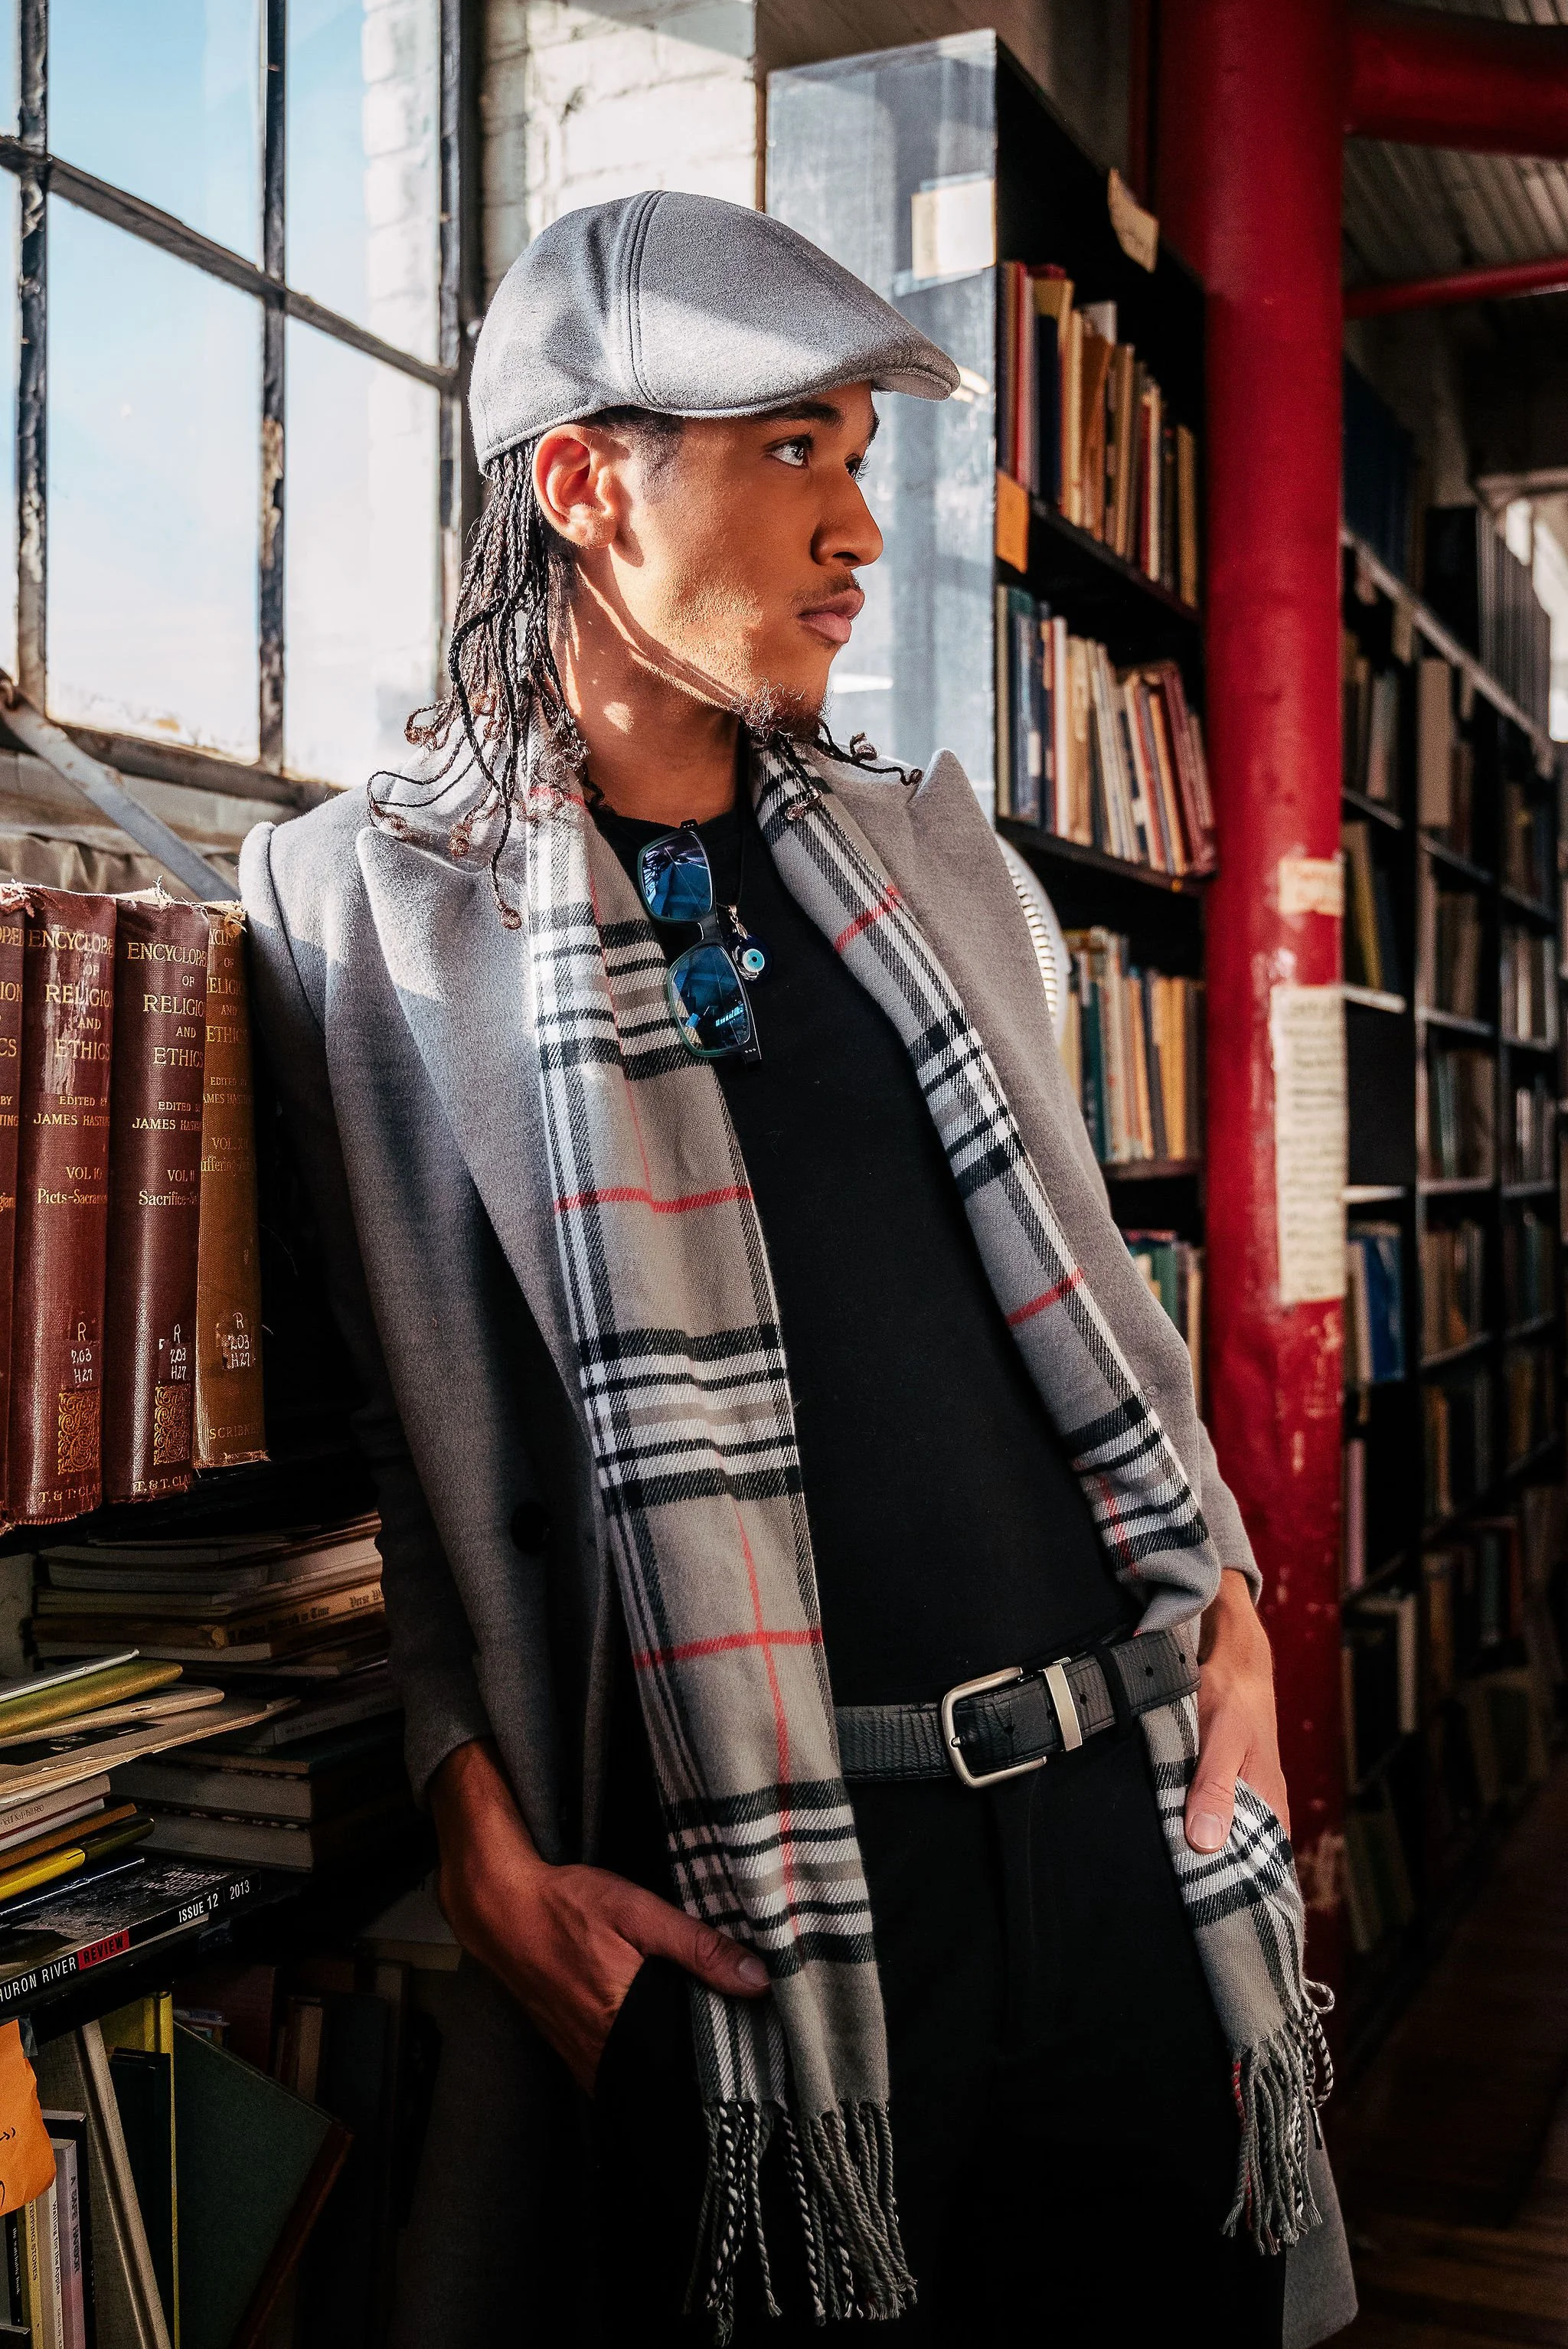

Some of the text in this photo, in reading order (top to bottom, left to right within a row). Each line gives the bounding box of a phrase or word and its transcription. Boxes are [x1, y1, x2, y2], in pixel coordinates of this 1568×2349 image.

[84, 964, 100, 976] OF
[182, 975, 194, 986] OF
[78, 1018, 101, 1030] AND
[175, 1027, 196, 1038] AND
[55, 1039, 110, 1061] ETHICS
[153, 1047, 204, 1067] ETHICS
[59, 1096, 95, 1106] EDITED
[158, 1101, 191, 1112] EDITED
[33, 1112, 78, 1125] JAMES
[132, 1118, 176, 1130] JAMES
[66, 1166, 91, 1180] VOL
[167, 1169, 188, 1182] VOL
[233, 1312, 244, 1329] R
[77, 1322, 87, 1341] R
[74, 1368, 93, 1384] H27
[171, 1365, 187, 1380] H27
[149, 1479, 158, 1490] &
[54, 1490, 63, 1501] &
[42, 1956, 77, 1984] RIVER
[83, 1935, 124, 1965] REVIEW
[178, 1900, 204, 1923] ISSUE
[207, 1893, 219, 1910] 12
[230, 1880, 250, 1900] 2013
